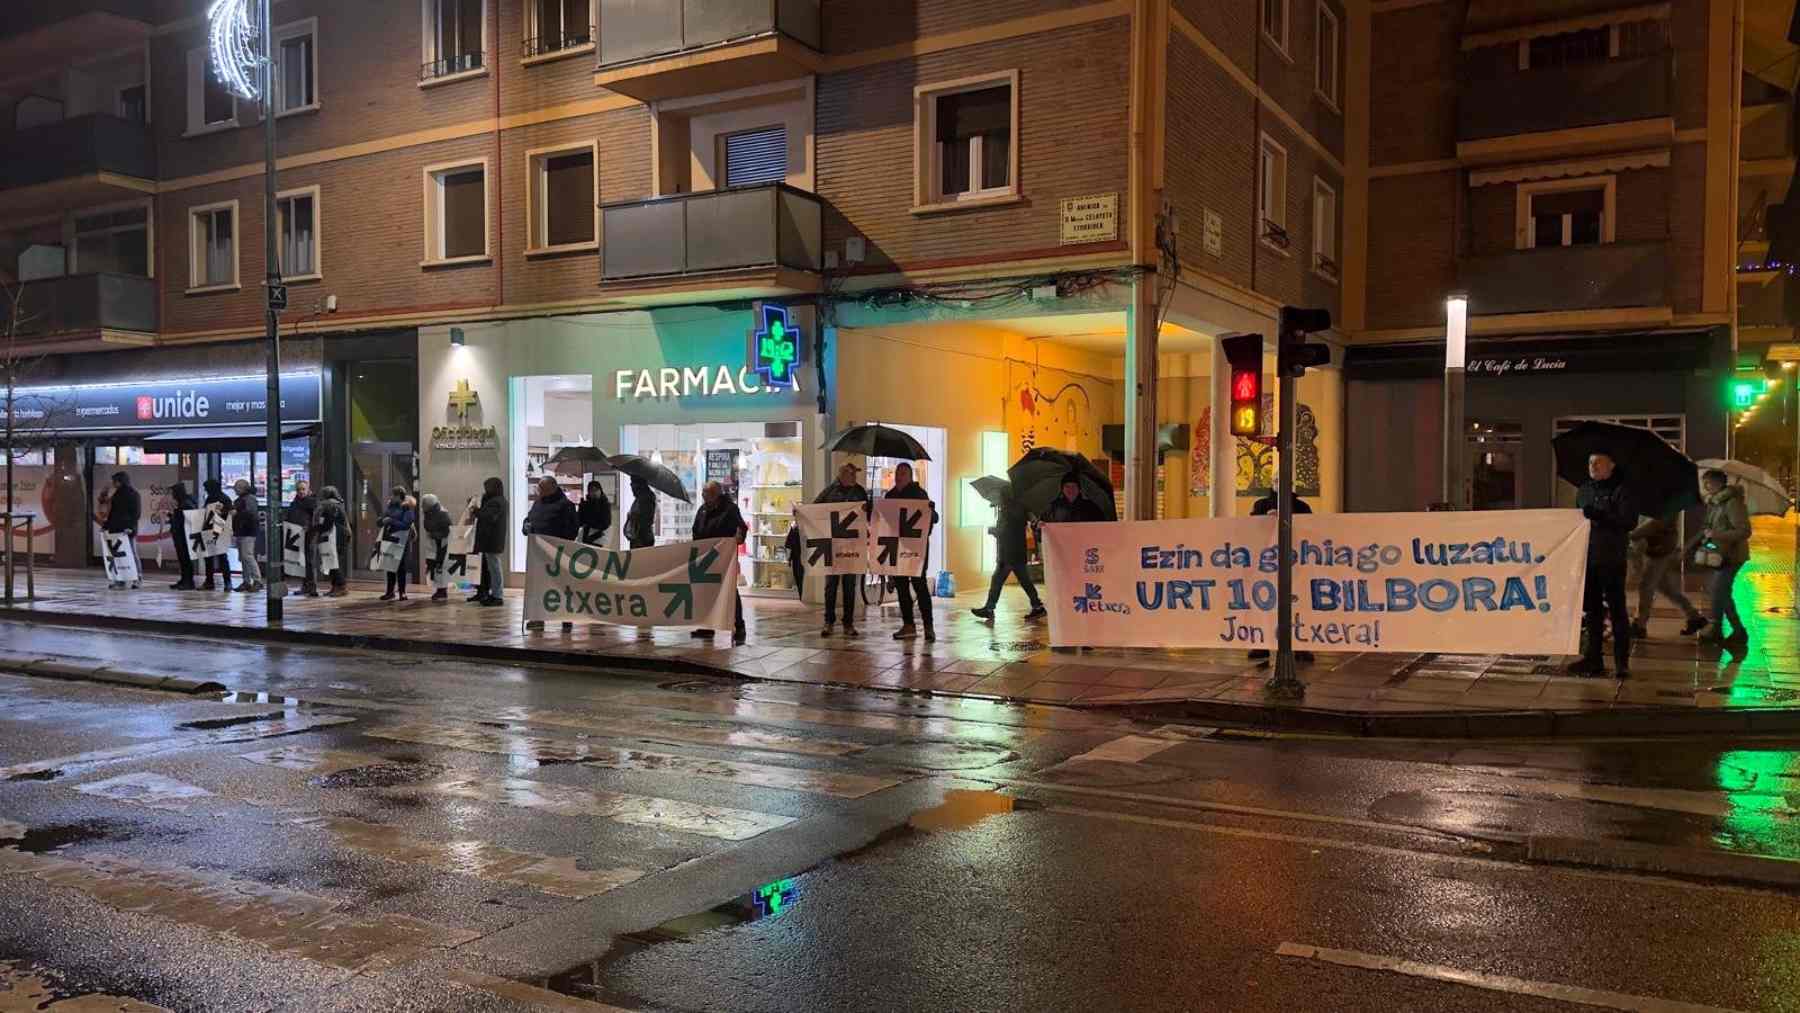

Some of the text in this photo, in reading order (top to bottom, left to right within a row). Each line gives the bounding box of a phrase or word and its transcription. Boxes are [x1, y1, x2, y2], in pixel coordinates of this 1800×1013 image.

[1514, 360, 1529, 370] de
[151, 391, 210, 418] unide
[545, 544, 632, 581] JON
[1141, 545, 1203, 569] Ezin
[1211, 542, 1251, 569] da
[543, 586, 648, 617] etxera
[1136, 579, 1216, 611] URT
[1220, 613, 1380, 647] Jon txera!
